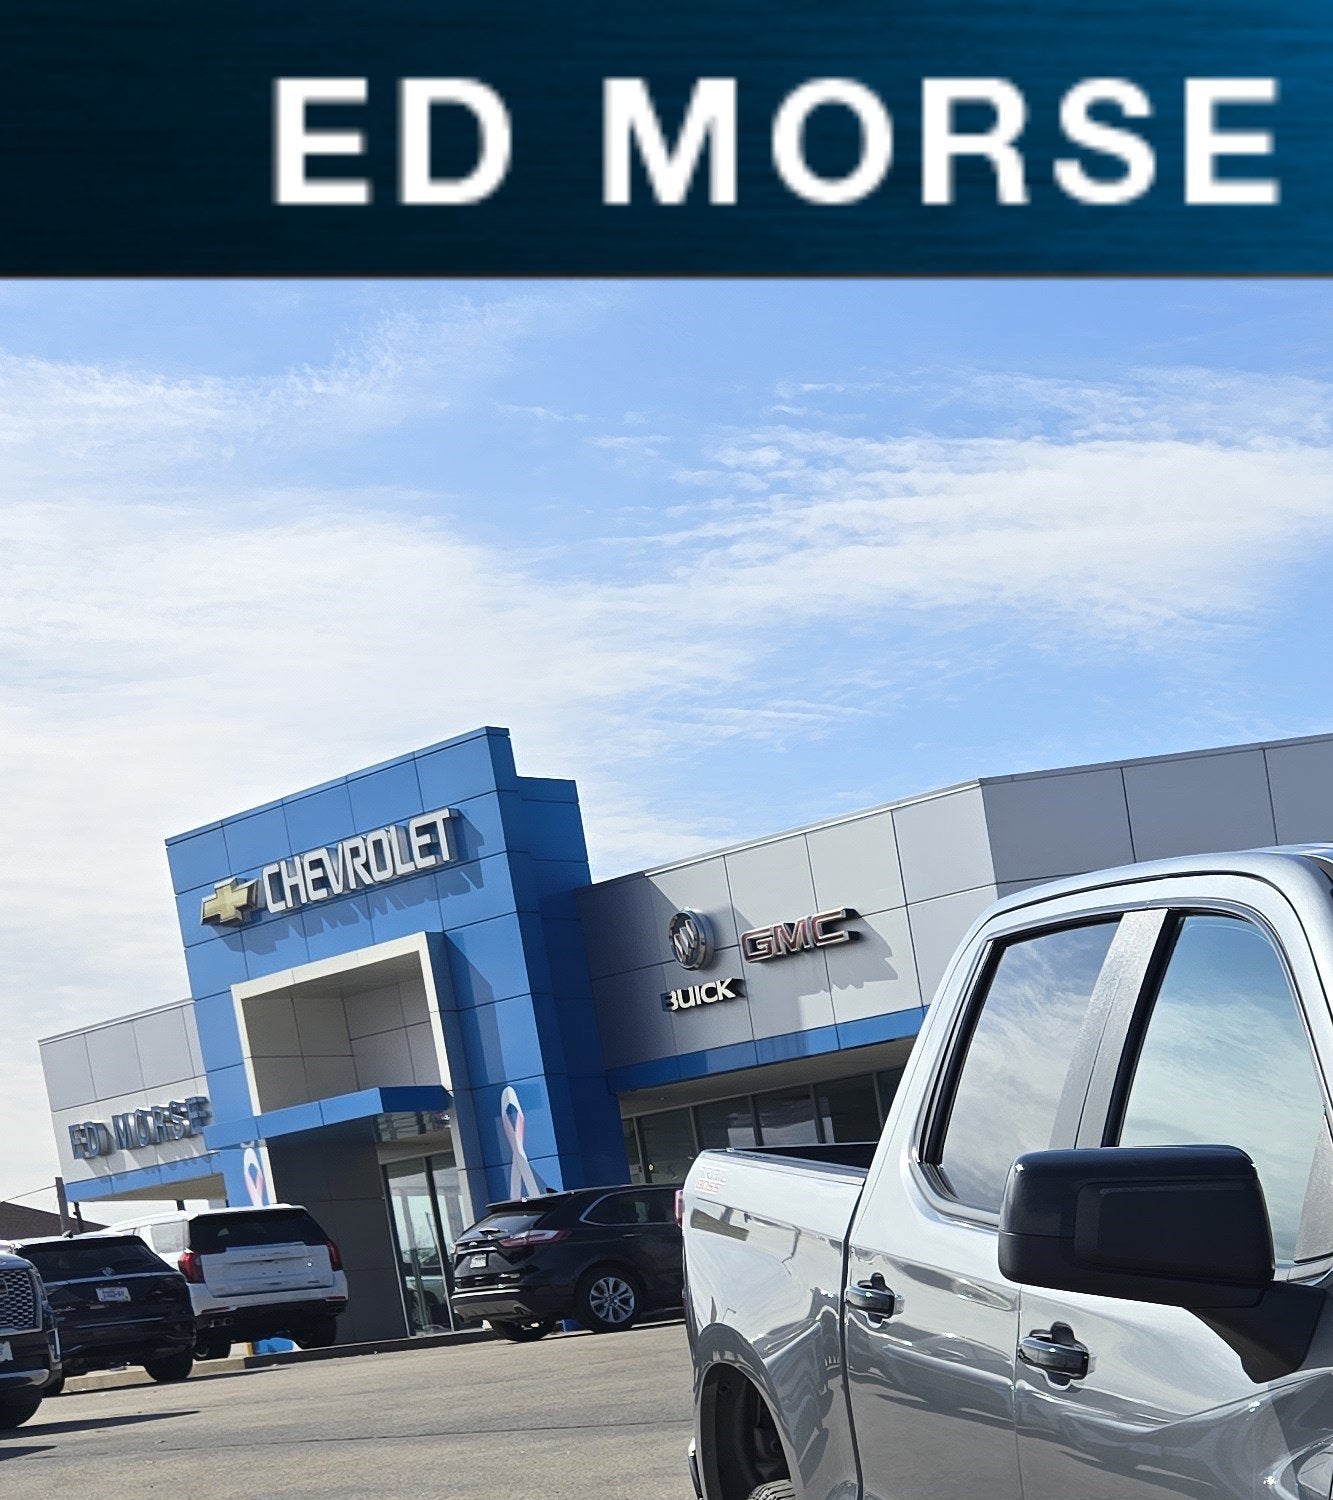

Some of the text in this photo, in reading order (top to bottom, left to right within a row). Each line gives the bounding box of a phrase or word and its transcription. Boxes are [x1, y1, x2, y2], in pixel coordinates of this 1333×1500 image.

[262, 808, 458, 914] CHEVROLET
[741, 907, 851, 963] GMC
[660, 977, 737, 1012] BUICK
[68, 1097, 211, 1160] ED MORSE
